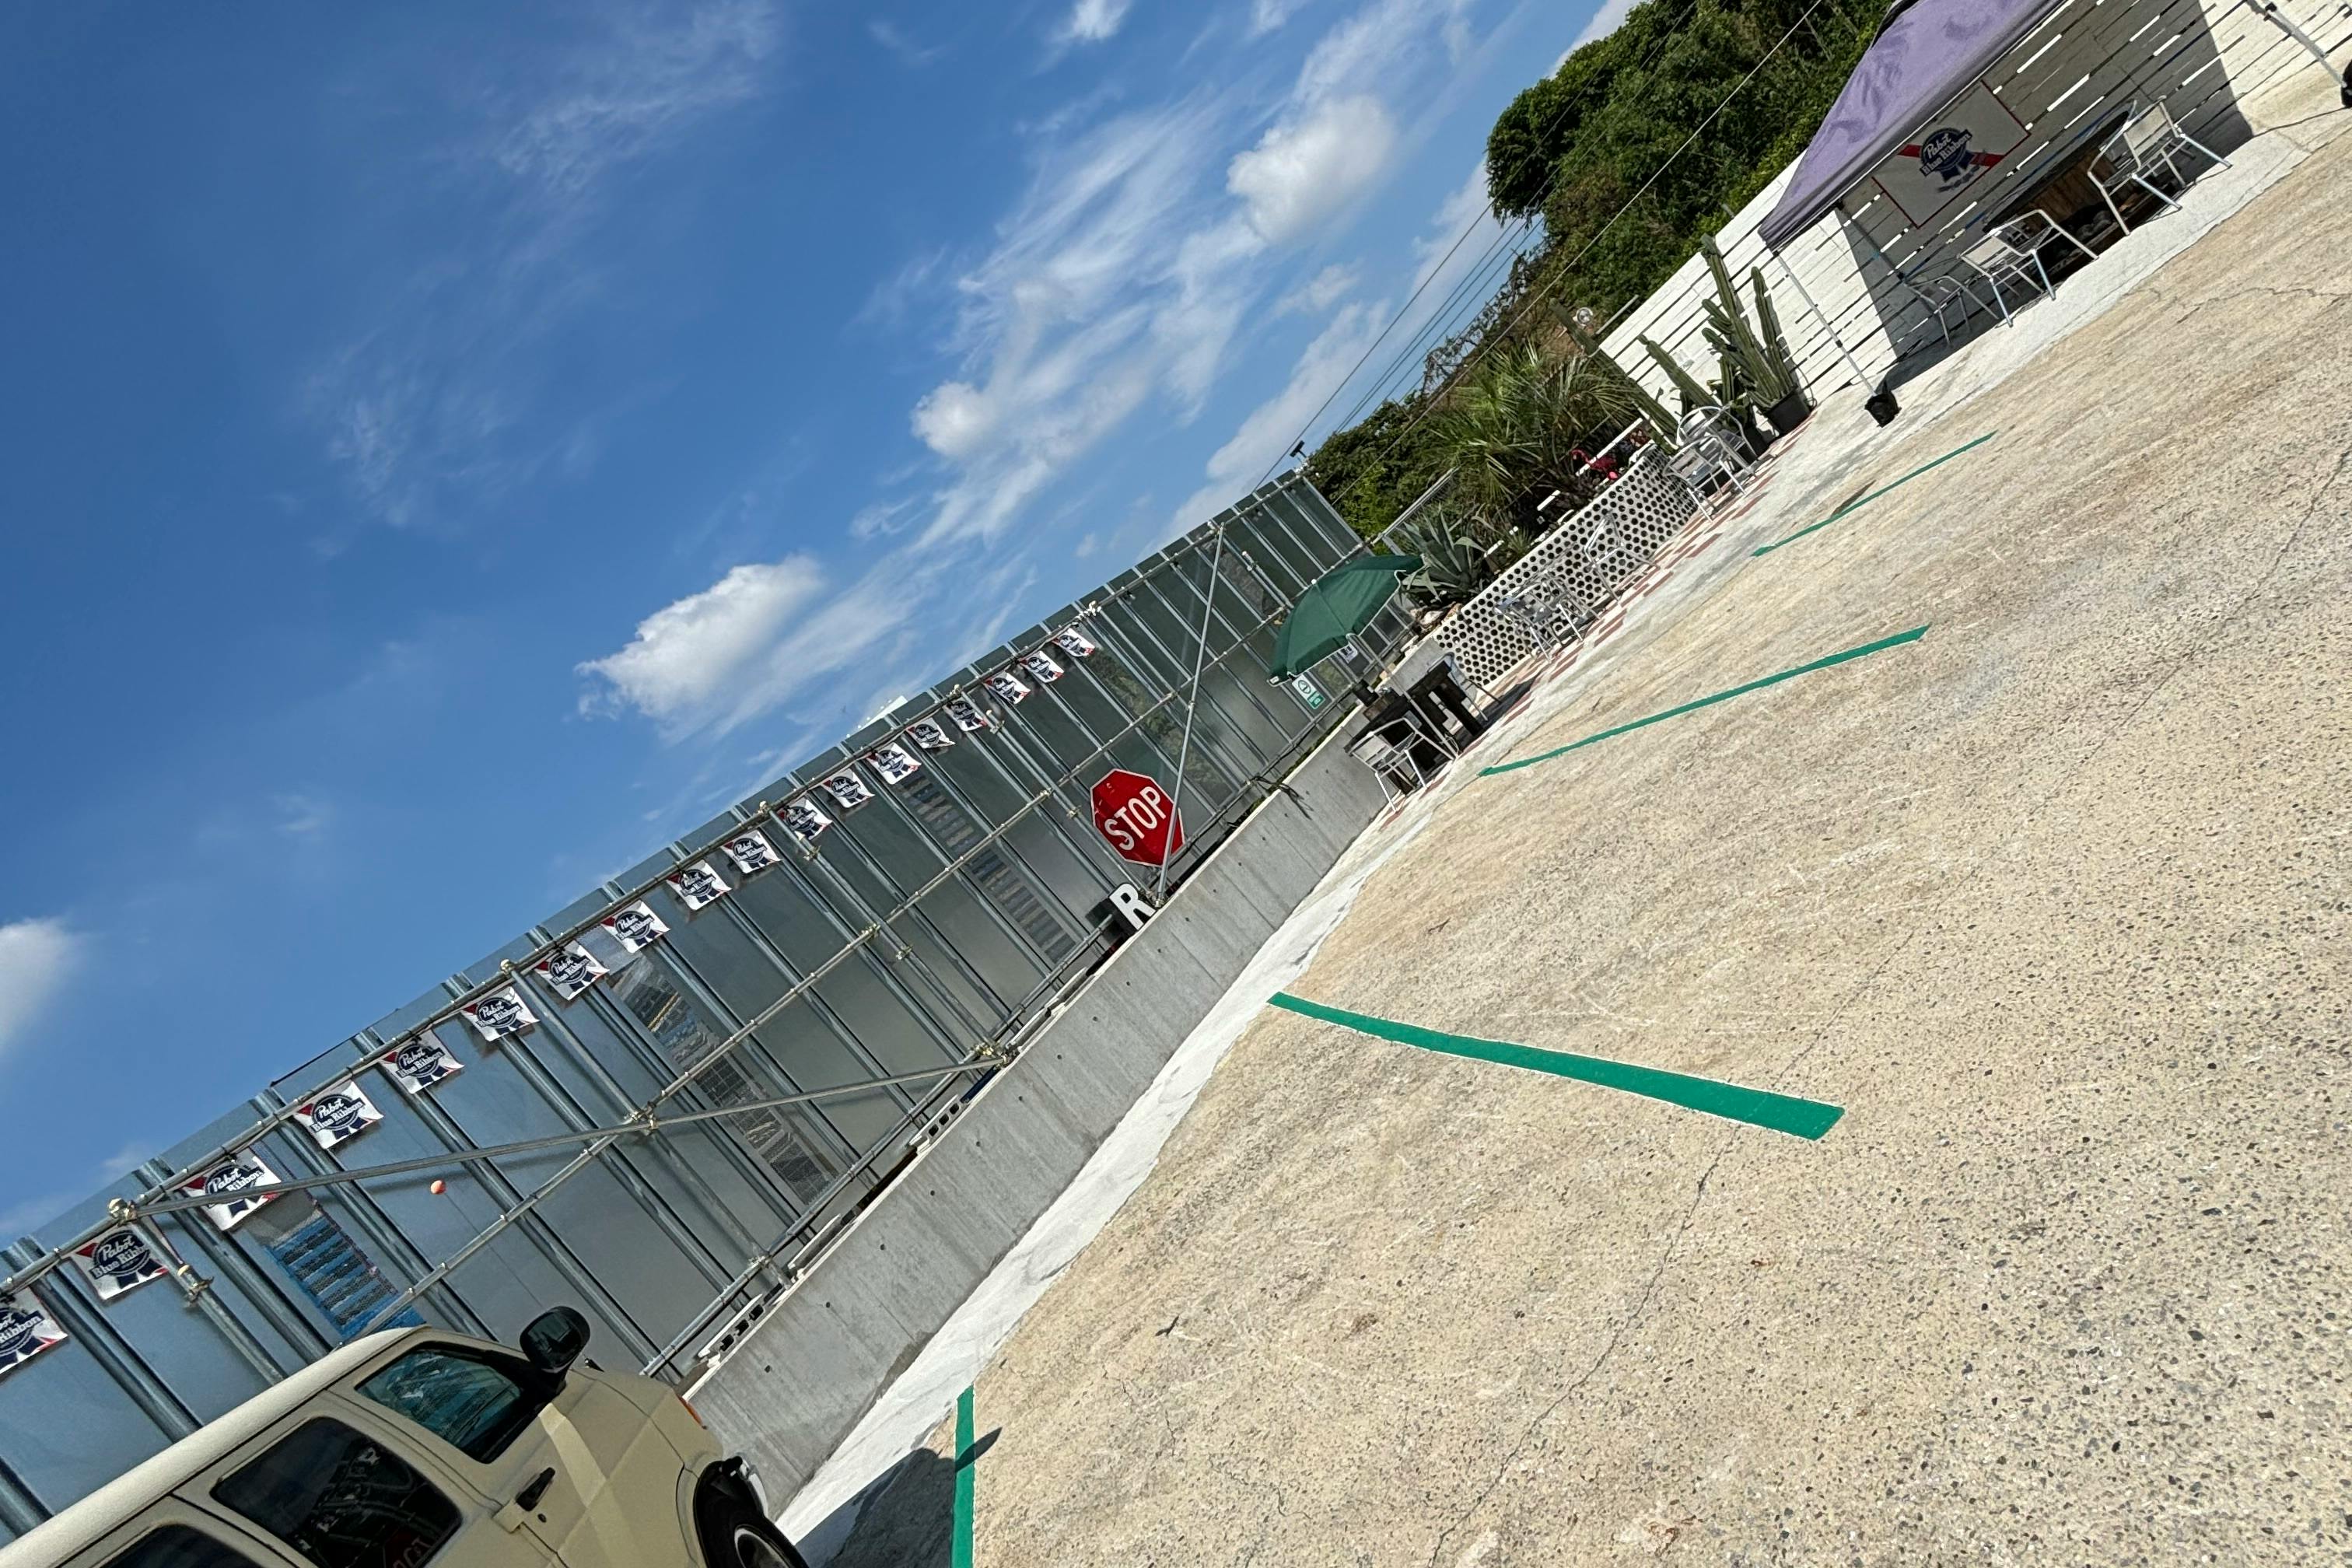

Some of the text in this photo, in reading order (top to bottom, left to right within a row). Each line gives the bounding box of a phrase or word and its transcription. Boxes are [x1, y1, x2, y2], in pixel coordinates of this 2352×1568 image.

[1922, 134, 1971, 175] Blue Ribbon
[1925, 134, 1951, 159] Pabst
[1104, 786, 1166, 851] STOP
[1108, 883, 1157, 930] R
[402, 1048, 426, 1066] Pabst
[414, 1052, 443, 1069] Ribbon
[312, 1115, 334, 1132] Blue
[332, 1101, 364, 1122] Ribbon
[318, 1099, 345, 1118] Pabst
[208, 1168, 242, 1192] Pabst
[228, 1170, 264, 1192] Ribbon
[99, 1235, 135, 1261] Pabst
[92, 1261, 120, 1278] Blue
[117, 1245, 147, 1264] Ribb
